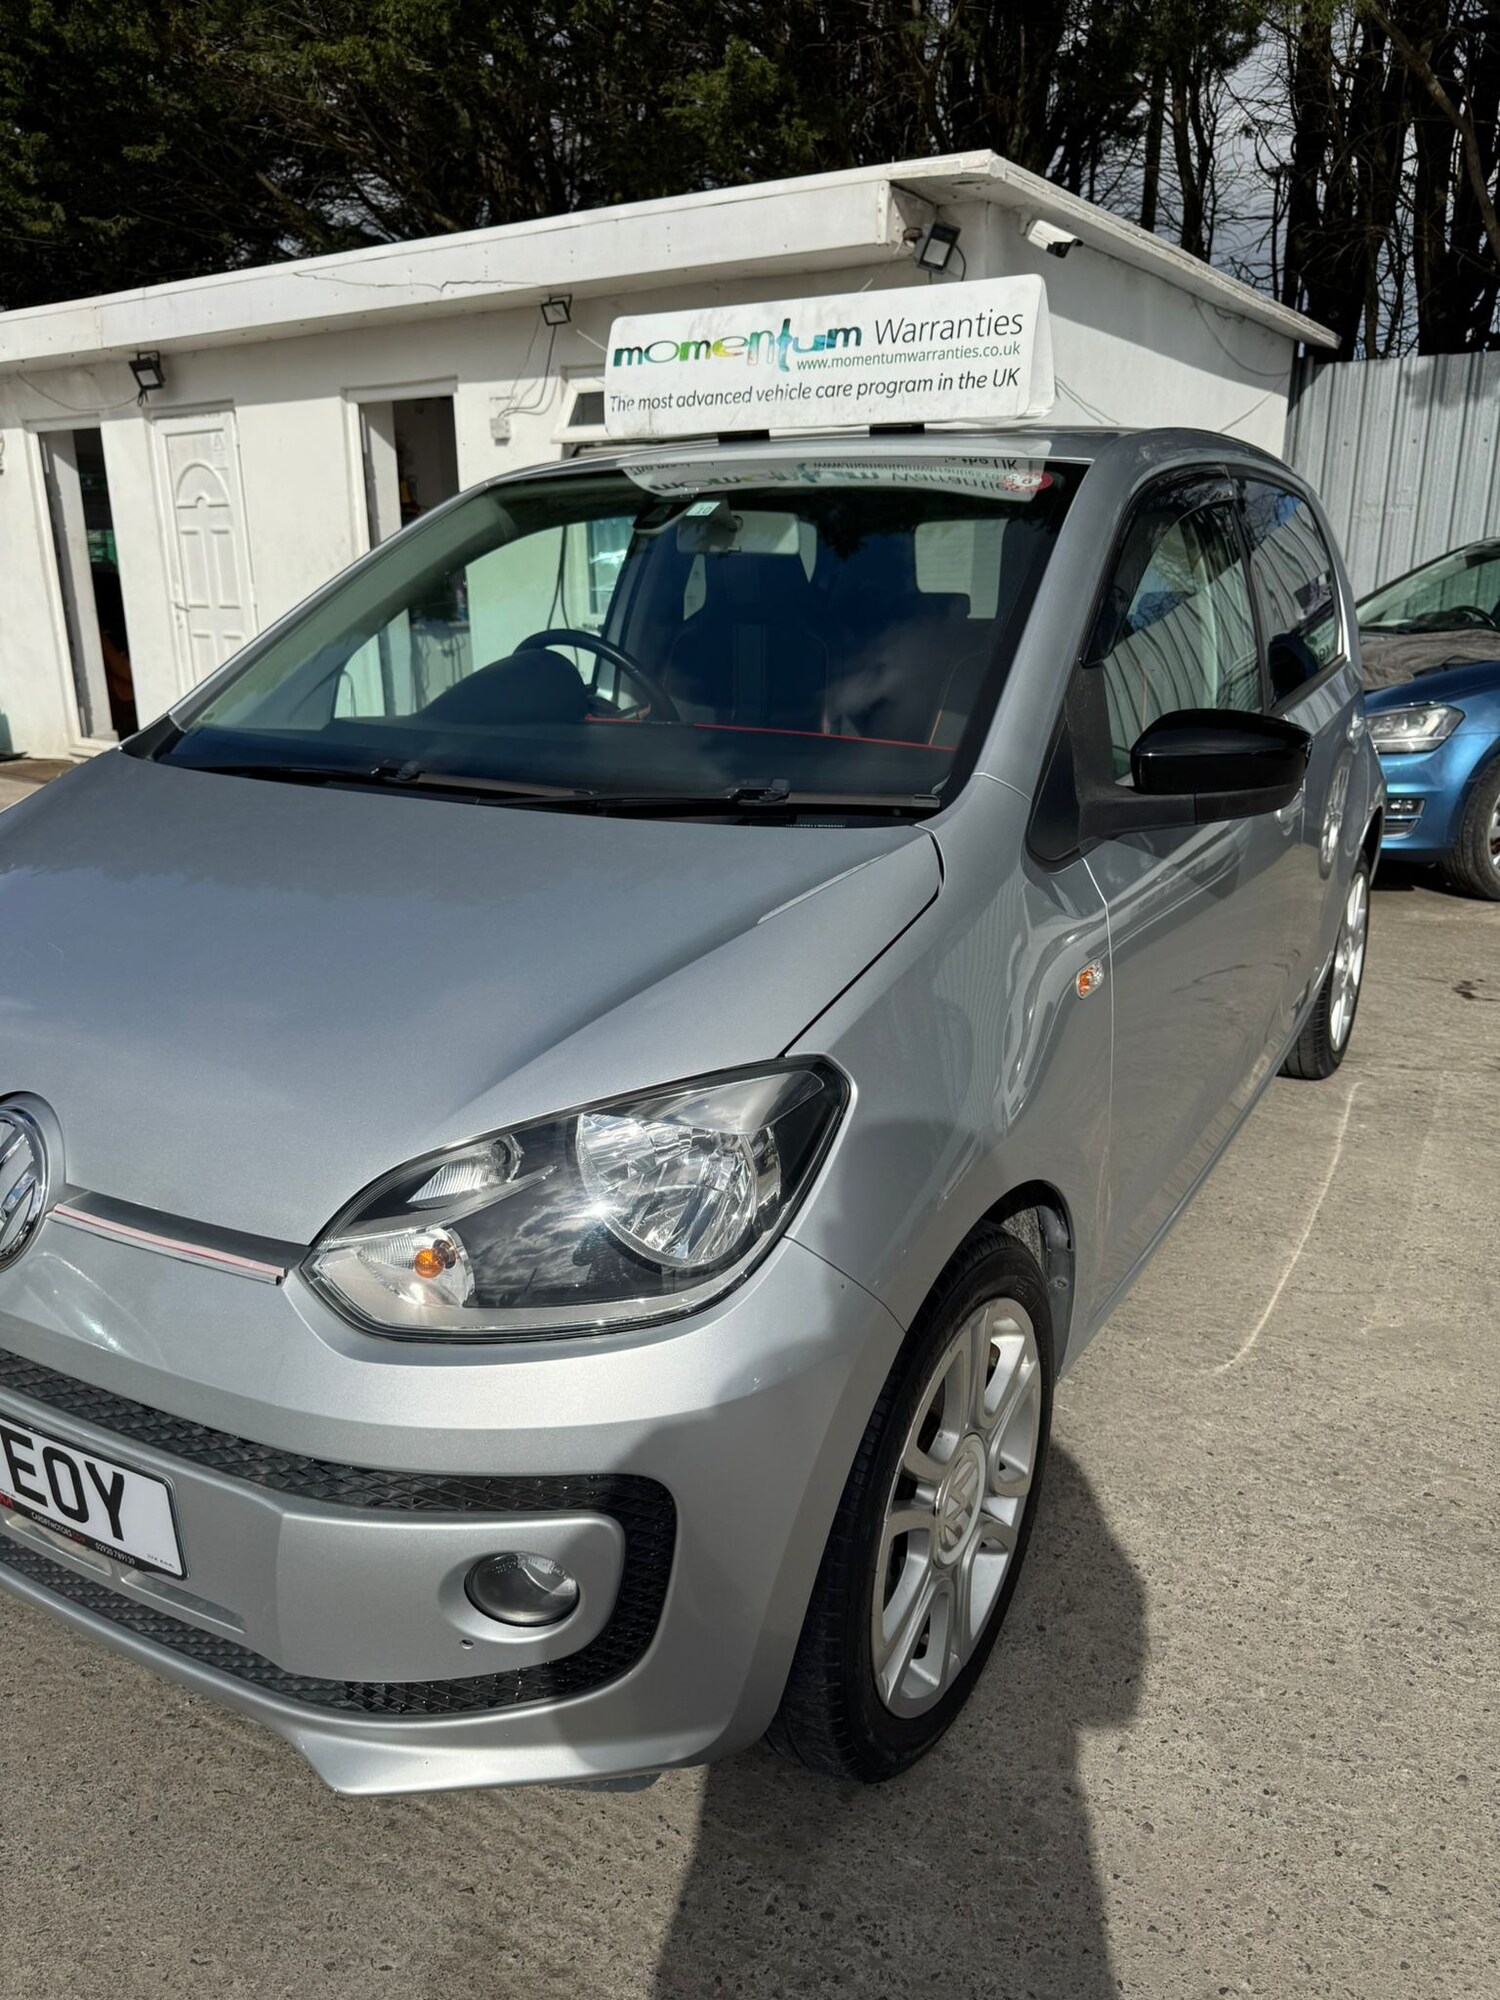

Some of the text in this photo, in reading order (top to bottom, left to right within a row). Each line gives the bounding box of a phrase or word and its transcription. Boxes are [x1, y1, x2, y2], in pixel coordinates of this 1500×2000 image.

[613, 308, 1024, 372] momentum Warranties
[797, 341, 1021, 371] www.momentumwarranties.co.uk
[610, 367, 1021, 412] The most advanced vehicle care program in the UK
[0, 1424, 125, 1542] EOY
